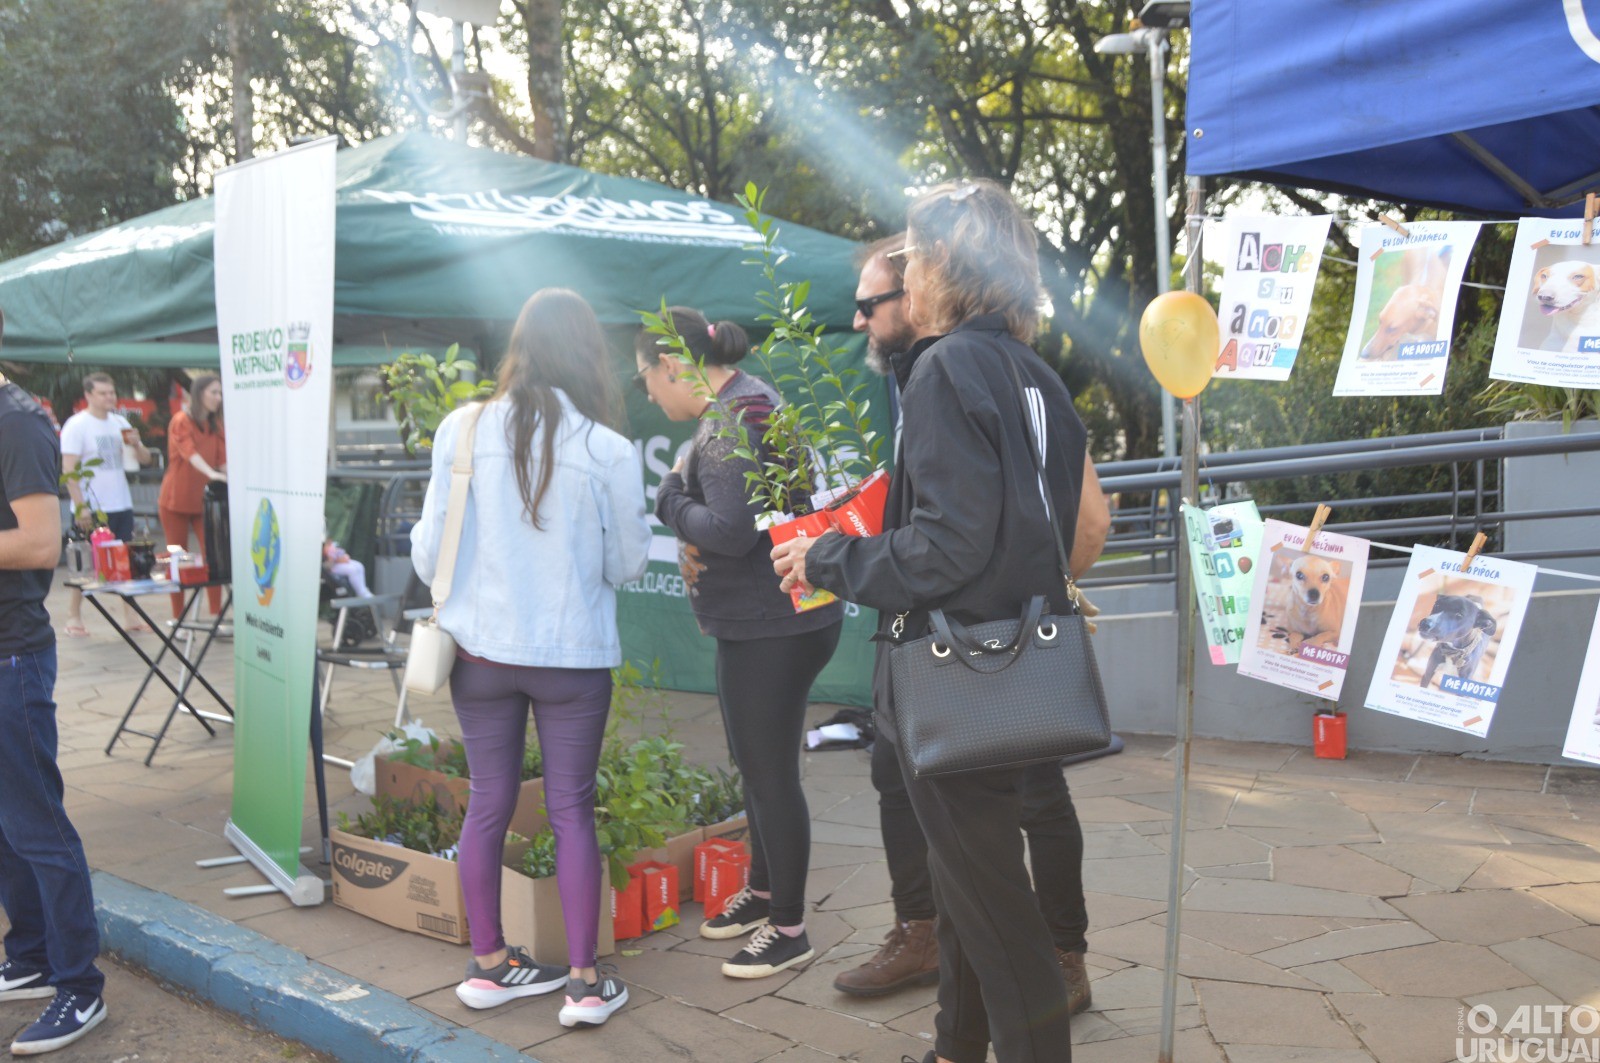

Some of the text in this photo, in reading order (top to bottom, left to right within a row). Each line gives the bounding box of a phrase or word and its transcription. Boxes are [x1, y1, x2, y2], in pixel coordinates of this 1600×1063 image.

[1472, 566, 1500, 579] PIPOCA
[1302, 646, 1347, 665] ME ADOTA?
[1444, 677, 1497, 698] ME ADOTA?
[334, 847, 393, 881] Colgate
